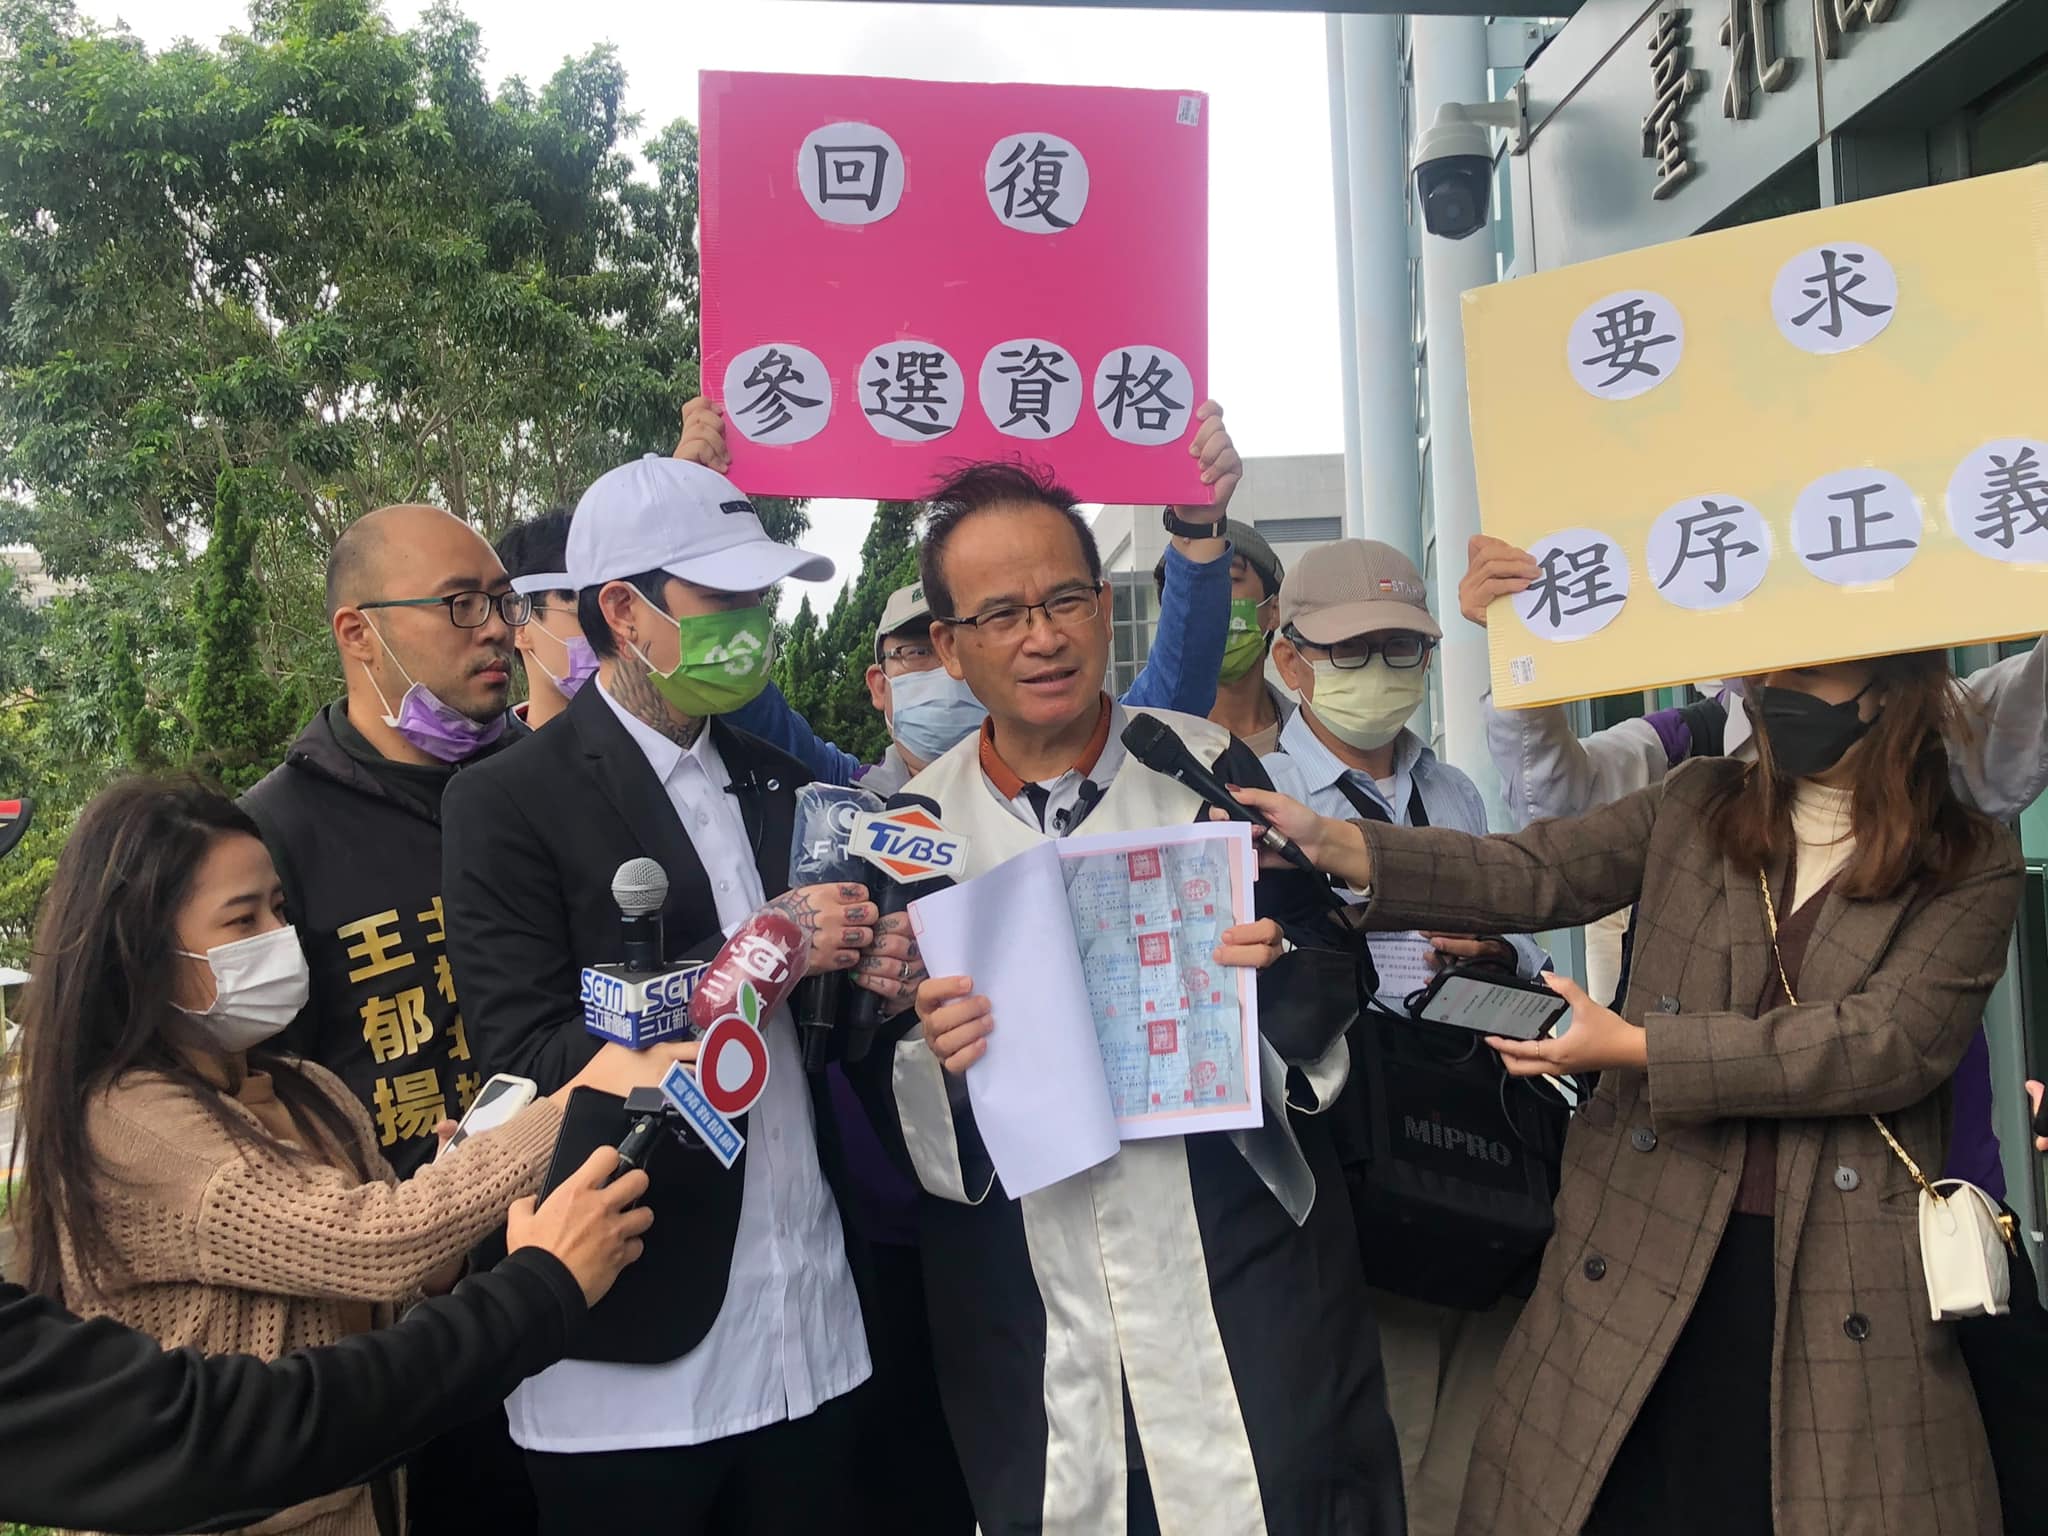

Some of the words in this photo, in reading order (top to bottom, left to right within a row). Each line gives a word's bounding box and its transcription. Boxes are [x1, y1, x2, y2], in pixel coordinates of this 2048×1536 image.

[814, 140, 1076, 230] 回復
[1582, 249, 1893, 388] 要求
[736, 347, 1186, 437] 參選資格
[1524, 447, 2048, 627] 程序正義
[867, 821, 958, 867] TVBS
[336, 908, 448, 1147] 王郁揚
[580, 969, 626, 1015] SETN
[639, 1005, 690, 1041] 三立新
